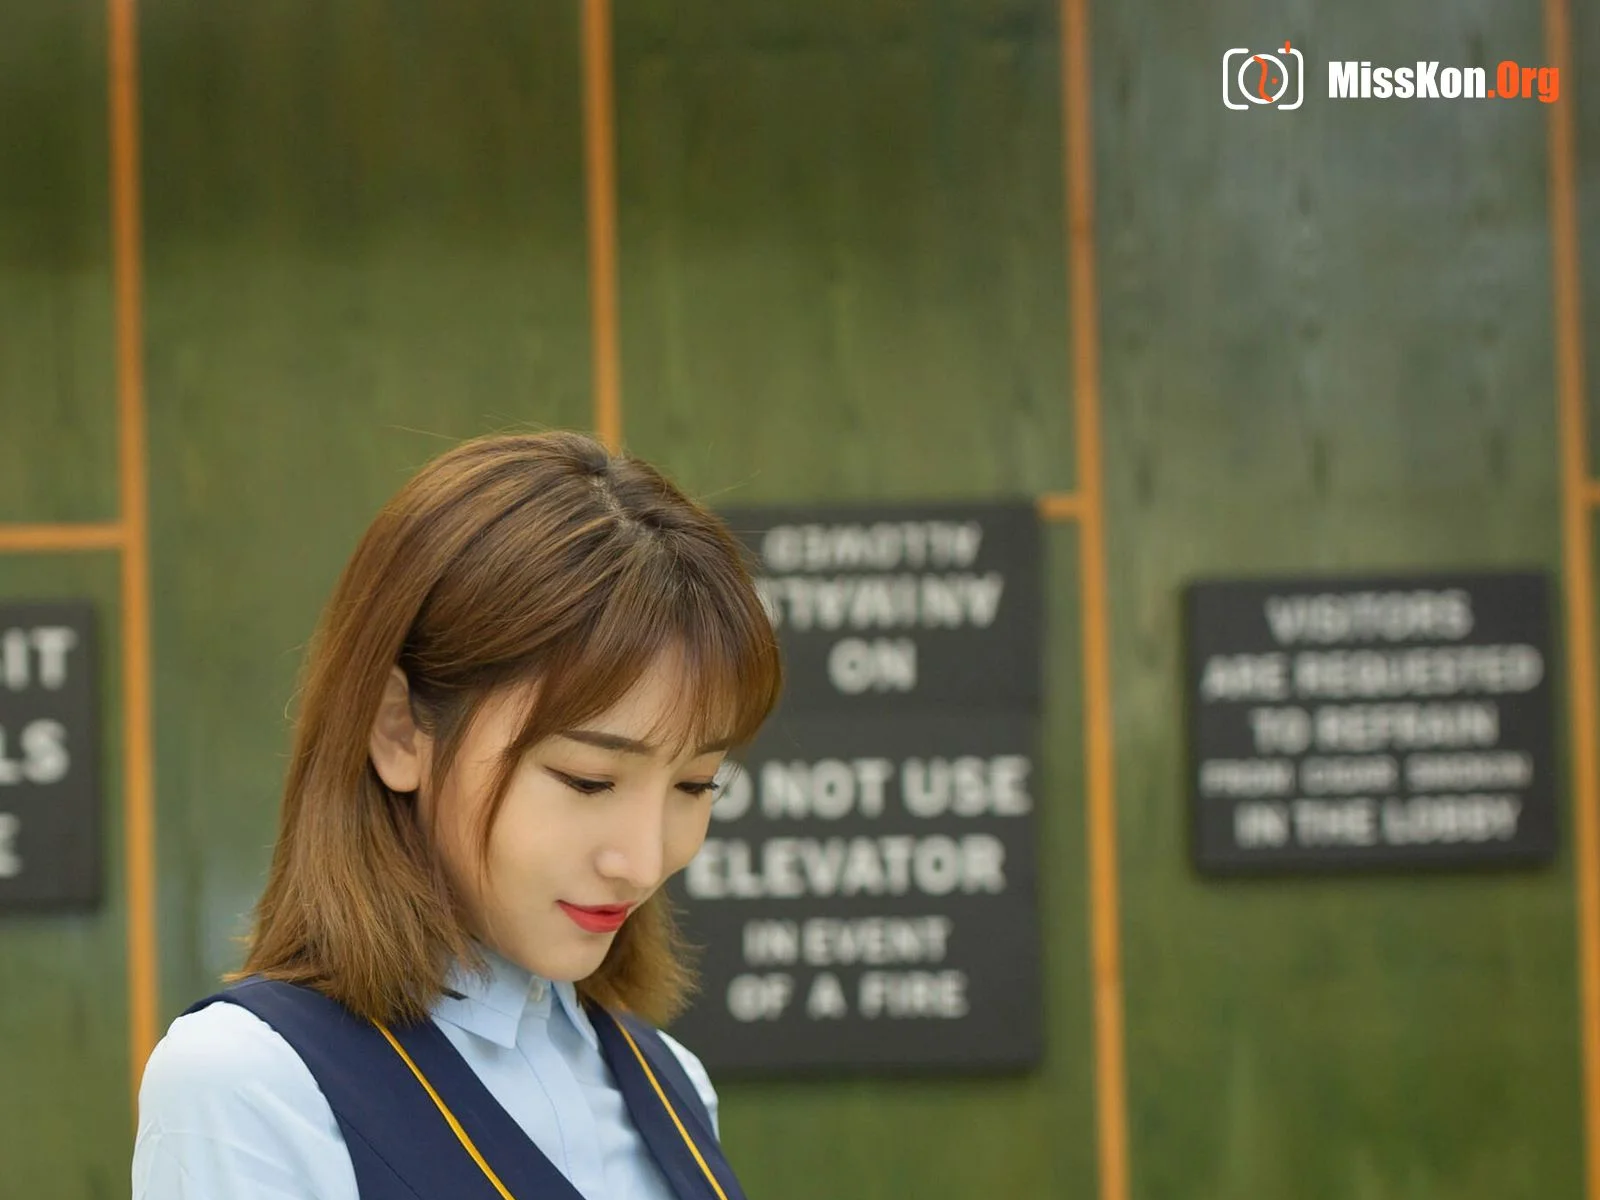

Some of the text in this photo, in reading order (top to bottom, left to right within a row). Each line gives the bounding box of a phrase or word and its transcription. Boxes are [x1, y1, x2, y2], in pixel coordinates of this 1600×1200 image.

[1267, 591, 1472, 642] VISITORS
[1203, 644, 1541, 700] ARE REQUESTED
[1252, 702, 1497, 752] TO REFRAIN
[760, 758, 893, 820] NOT
[902, 756, 1031, 818] USE
[1236, 796, 1518, 847] IN THE LOBBY
[687, 836, 1005, 898] ELEVATOR
[744, 916, 949, 966] IN EVENT
[728, 971, 966, 1021] OF A FIRE
